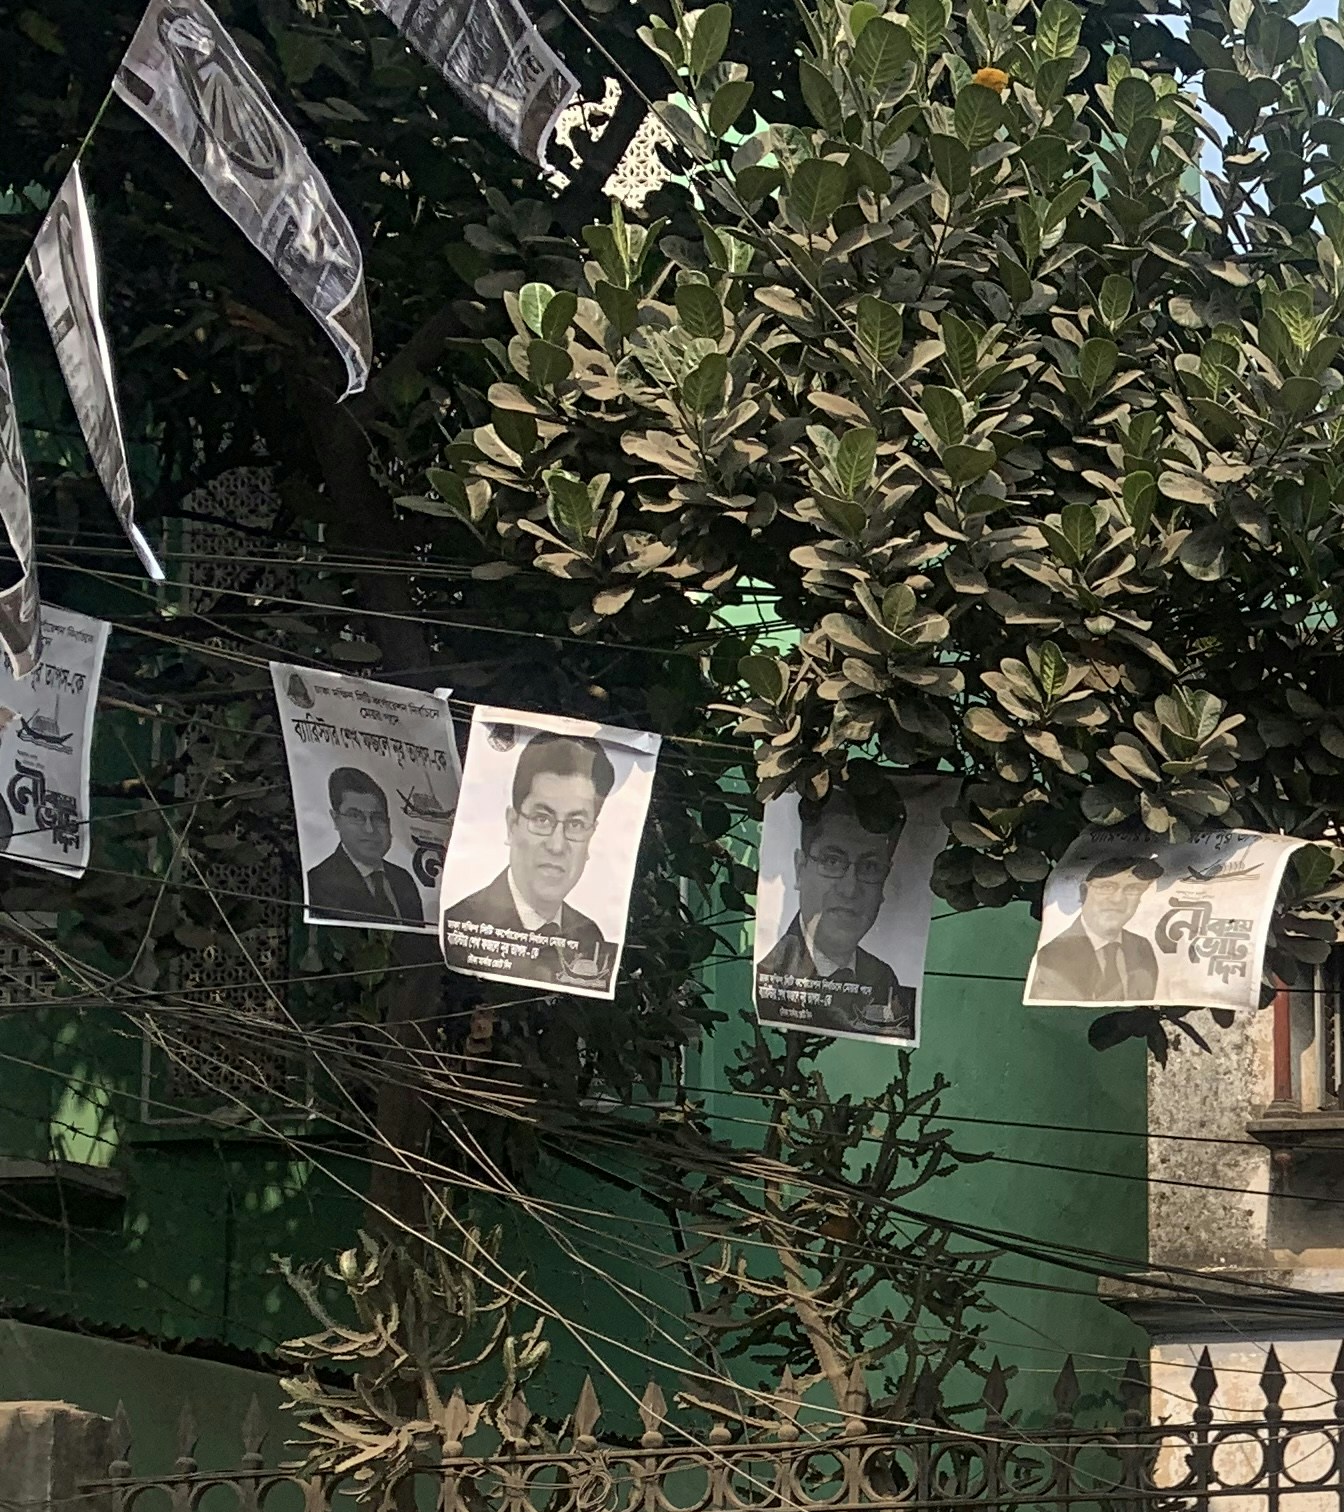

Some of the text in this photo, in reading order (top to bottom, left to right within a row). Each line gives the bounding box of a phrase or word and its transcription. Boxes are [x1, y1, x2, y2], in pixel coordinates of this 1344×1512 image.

[1155, 898, 1253, 953] নৌকায়
[1189, 934, 1250, 963] ভোট
[1207, 956, 1246, 983] দিন
